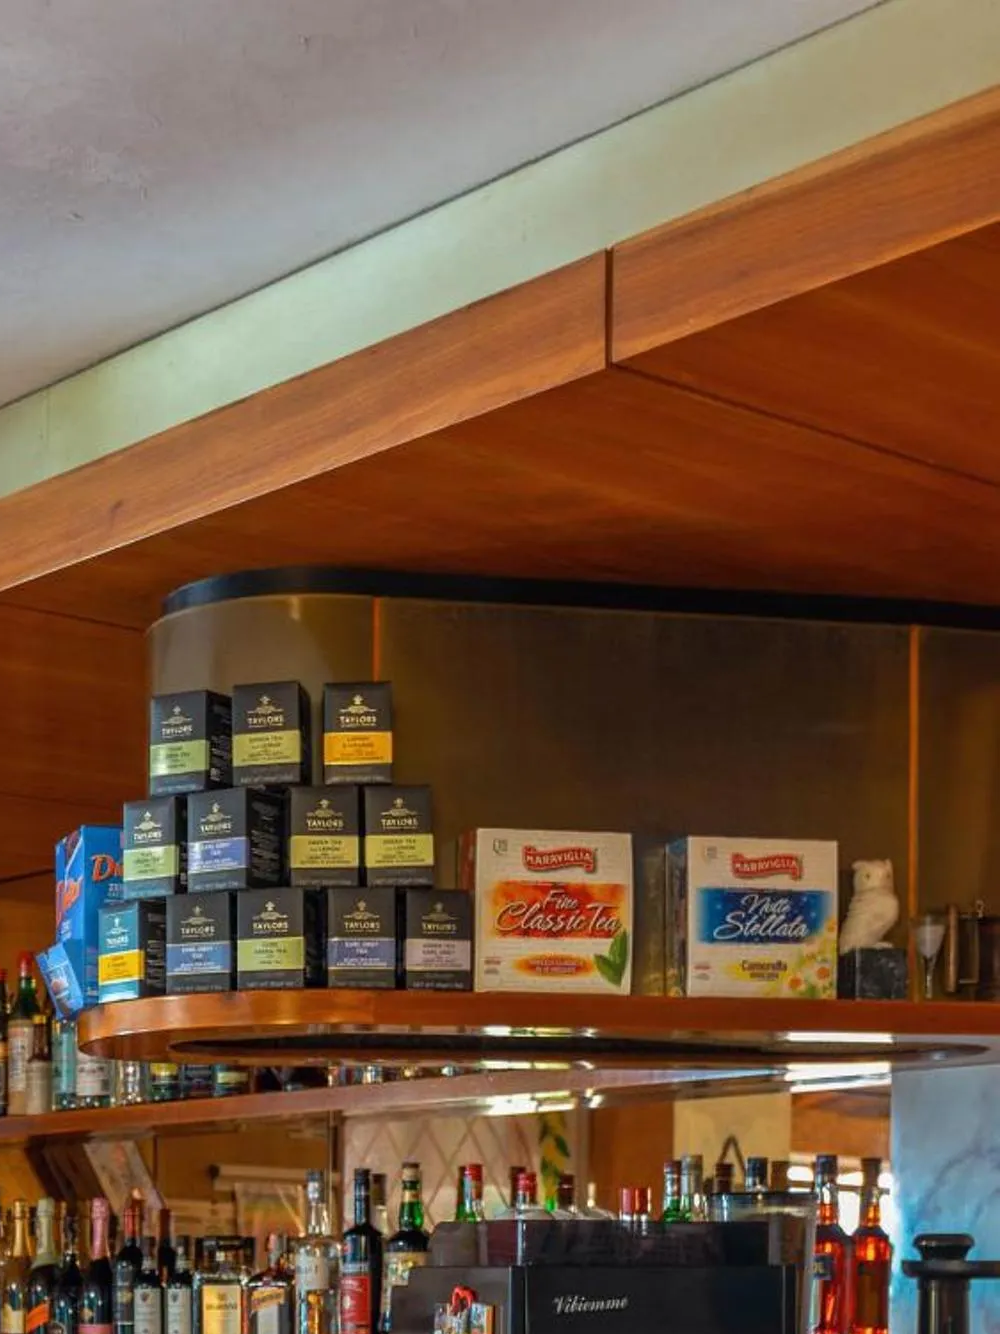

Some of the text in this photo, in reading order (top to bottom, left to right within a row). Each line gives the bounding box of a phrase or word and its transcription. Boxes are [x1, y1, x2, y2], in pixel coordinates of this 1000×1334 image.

[247, 714, 284, 725] TAYLORS
[339, 715, 377, 724] TAYLORS
[200, 822, 232, 833] TAYLORS
[306, 819, 344, 828] TAYLORS
[381, 818, 419, 827] TAYLORS
[133, 831, 163, 841] TAYLORS
[525, 851, 594, 866] MARAVIGLIA
[734, 858, 799, 872] MARAVIGLIA
[542, 889, 579, 911] Fine
[496, 901, 622, 934] Classic Tea
[252, 921, 289, 930] TAYLORS
[343, 921, 381, 929] TAYLORS
[421, 922, 457, 931] TAYLORS
[713, 911, 809, 940] Stellata
[180, 926, 216, 935] TAYLORS
[552, 1295, 629, 1315] Vibiemme
